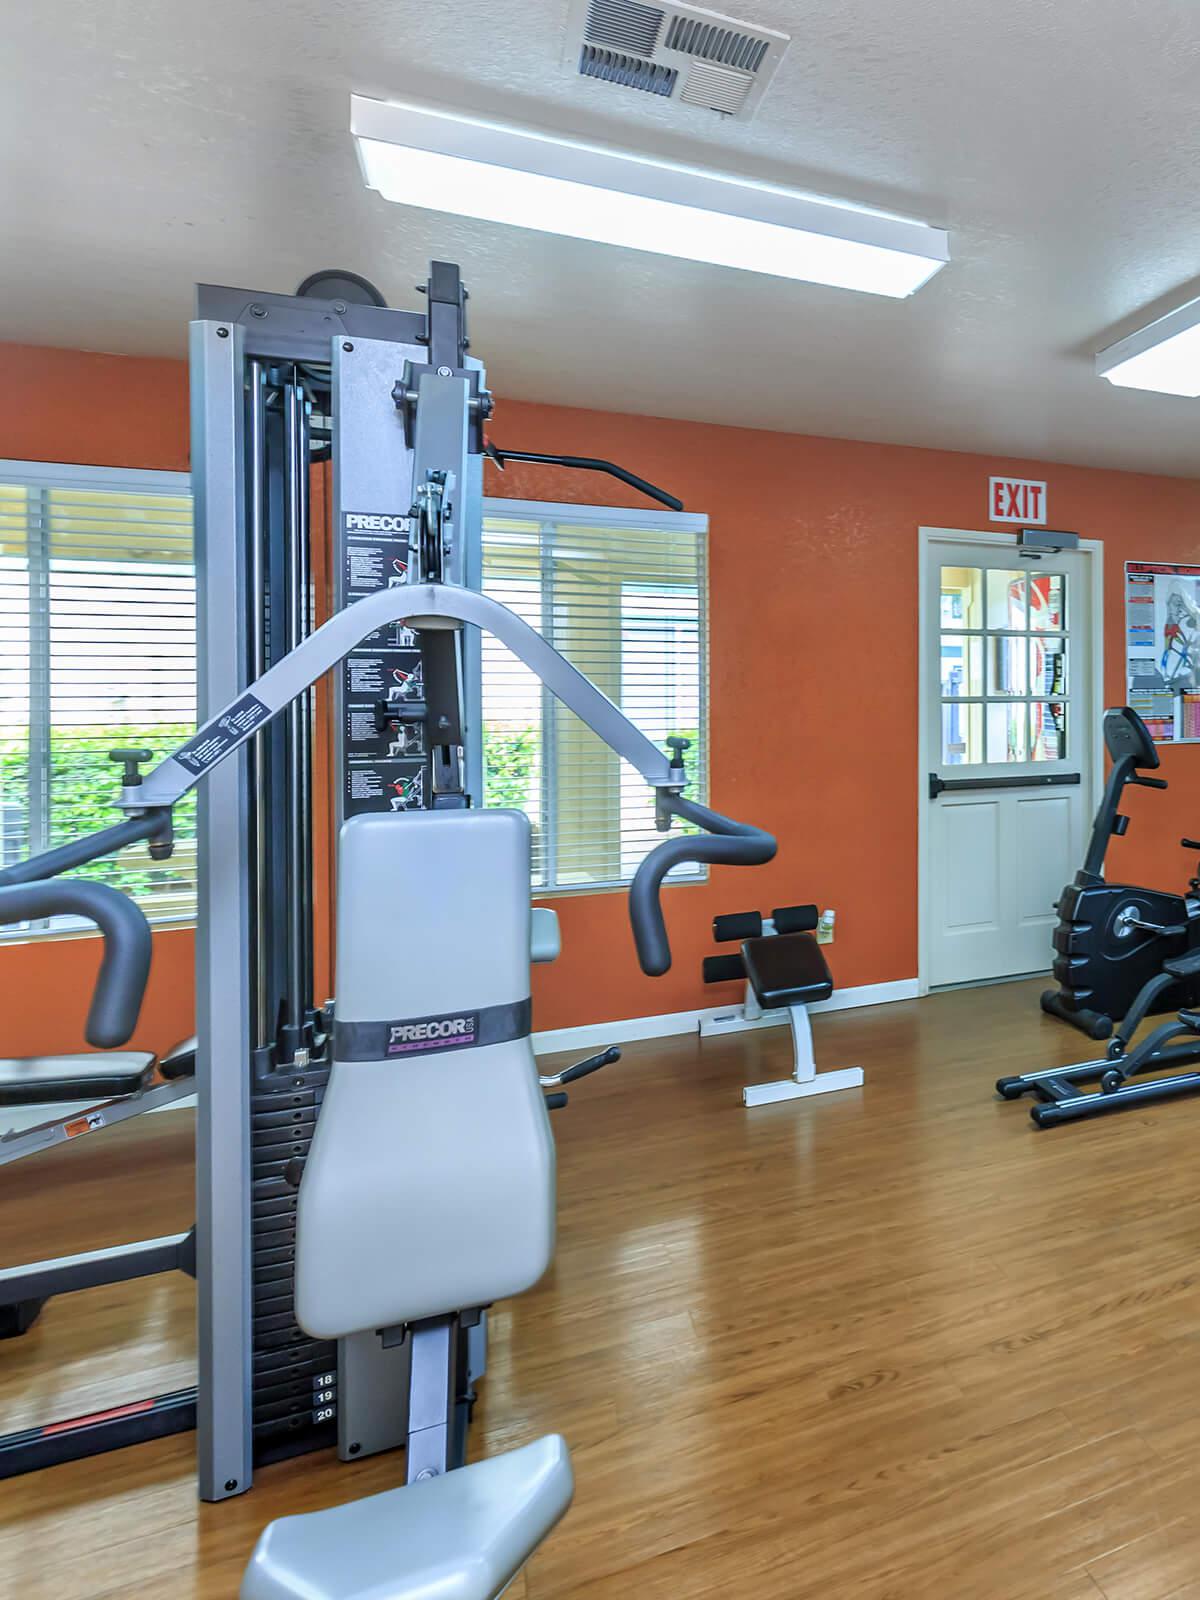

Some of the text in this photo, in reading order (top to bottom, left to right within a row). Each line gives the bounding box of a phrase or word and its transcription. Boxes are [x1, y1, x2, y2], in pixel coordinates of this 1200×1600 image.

[993, 482, 1042, 519] EXIT
[389, 1018, 466, 1043] PRECOR
[317, 1375, 333, 1386] 18
[317, 1391, 333, 1402] 19
[317, 1408, 333, 1421] 20
